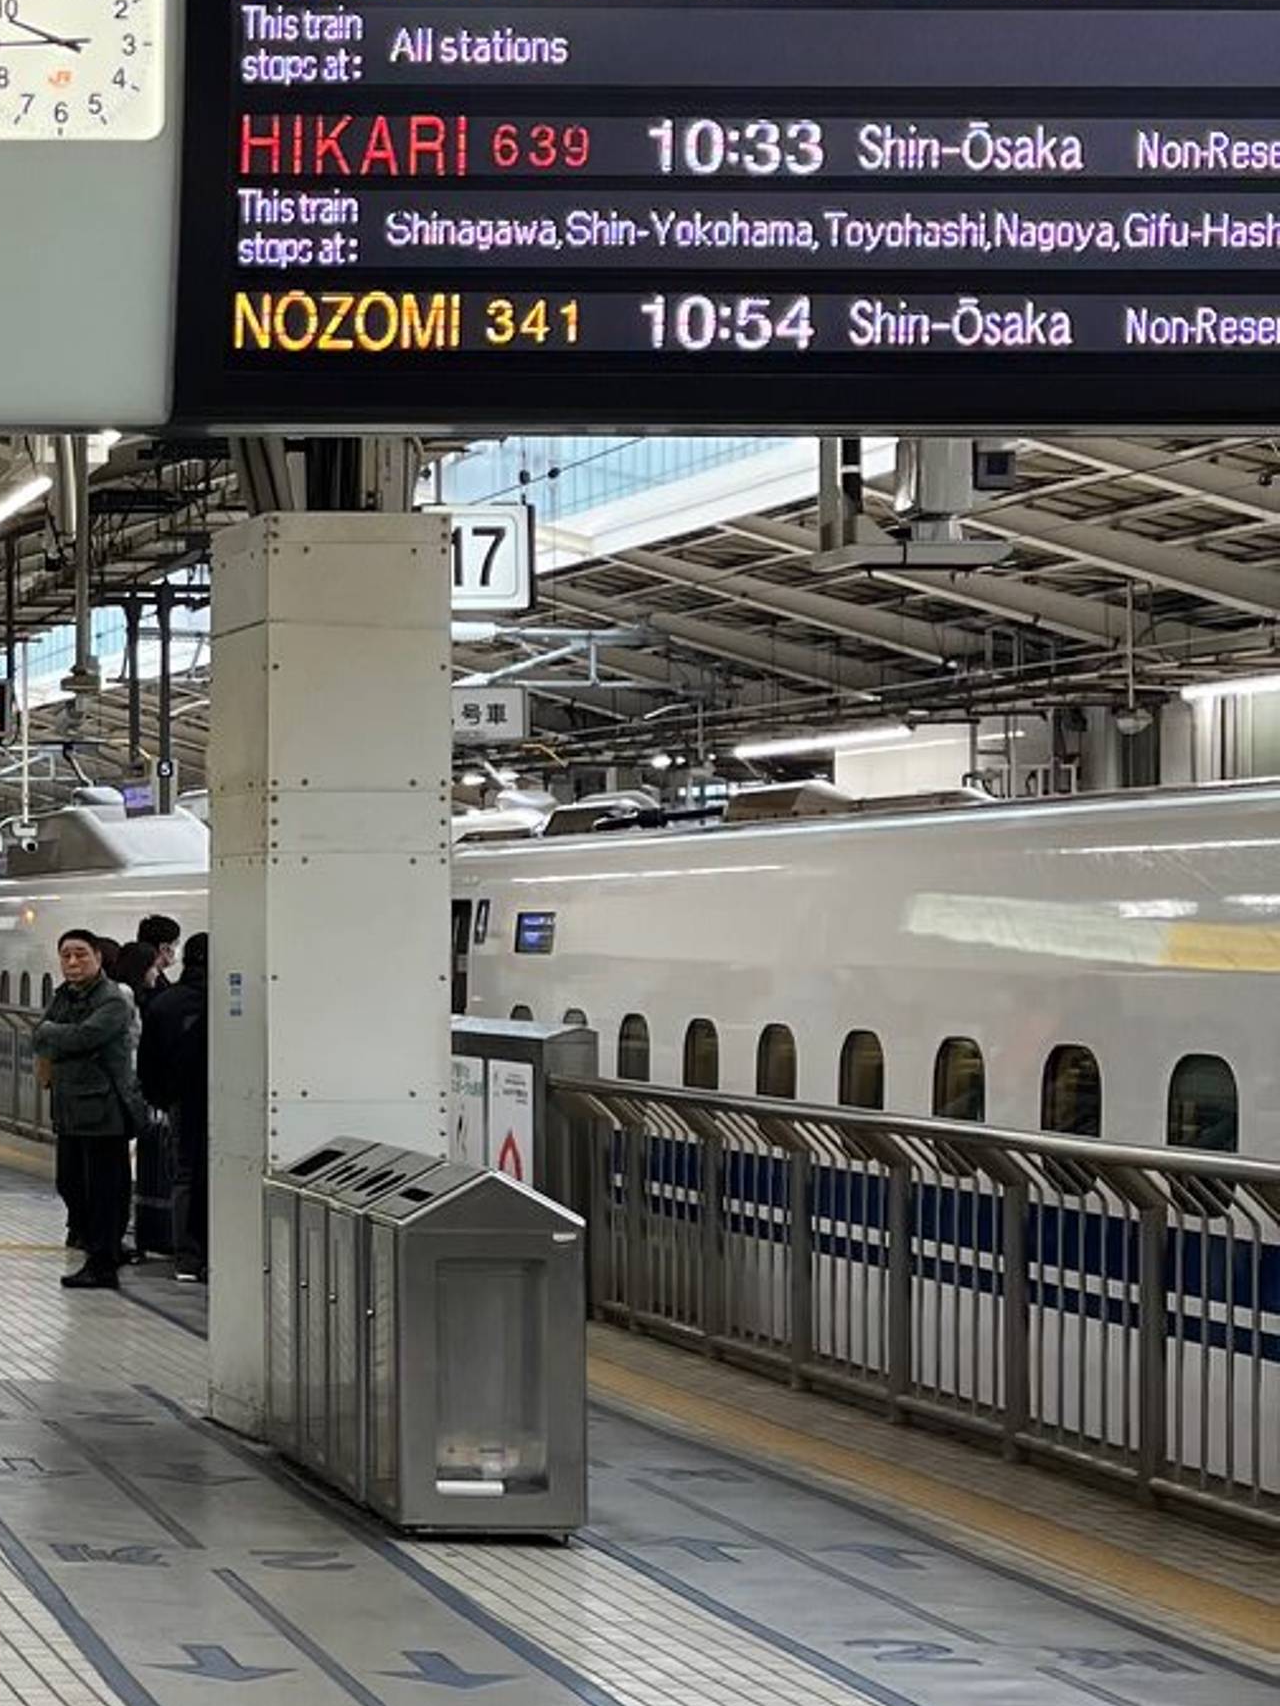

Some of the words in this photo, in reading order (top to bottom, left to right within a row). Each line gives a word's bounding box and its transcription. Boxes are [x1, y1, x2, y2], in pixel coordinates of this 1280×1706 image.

[114, 0, 128, 19] 2
[242, 5, 299, 41] This
[303, 6, 362, 41] train
[122, 34, 137, 56] 3
[390, 28, 432, 61] All
[440, 28, 567, 63] stations
[112, 68, 125, 89] 4
[21, 93, 35, 115] 7
[54, 101, 68, 124] 6
[88, 93, 102, 115] 5
[242, 115, 466, 175] HIKARI
[494, 125, 588, 166] 639
[649, 119, 823, 174] 10:33
[859, 122, 1083, 170] Shin-Ōsaka
[238, 189, 294, 223] This
[299, 190, 359, 223] train
[236, 291, 459, 350] NOZOMI
[487, 300, 576, 342] 341
[642, 295, 814, 349] 10:54
[850, 298, 1072, 345] Shin-Ōsaka
[452, 526, 506, 587] 17
